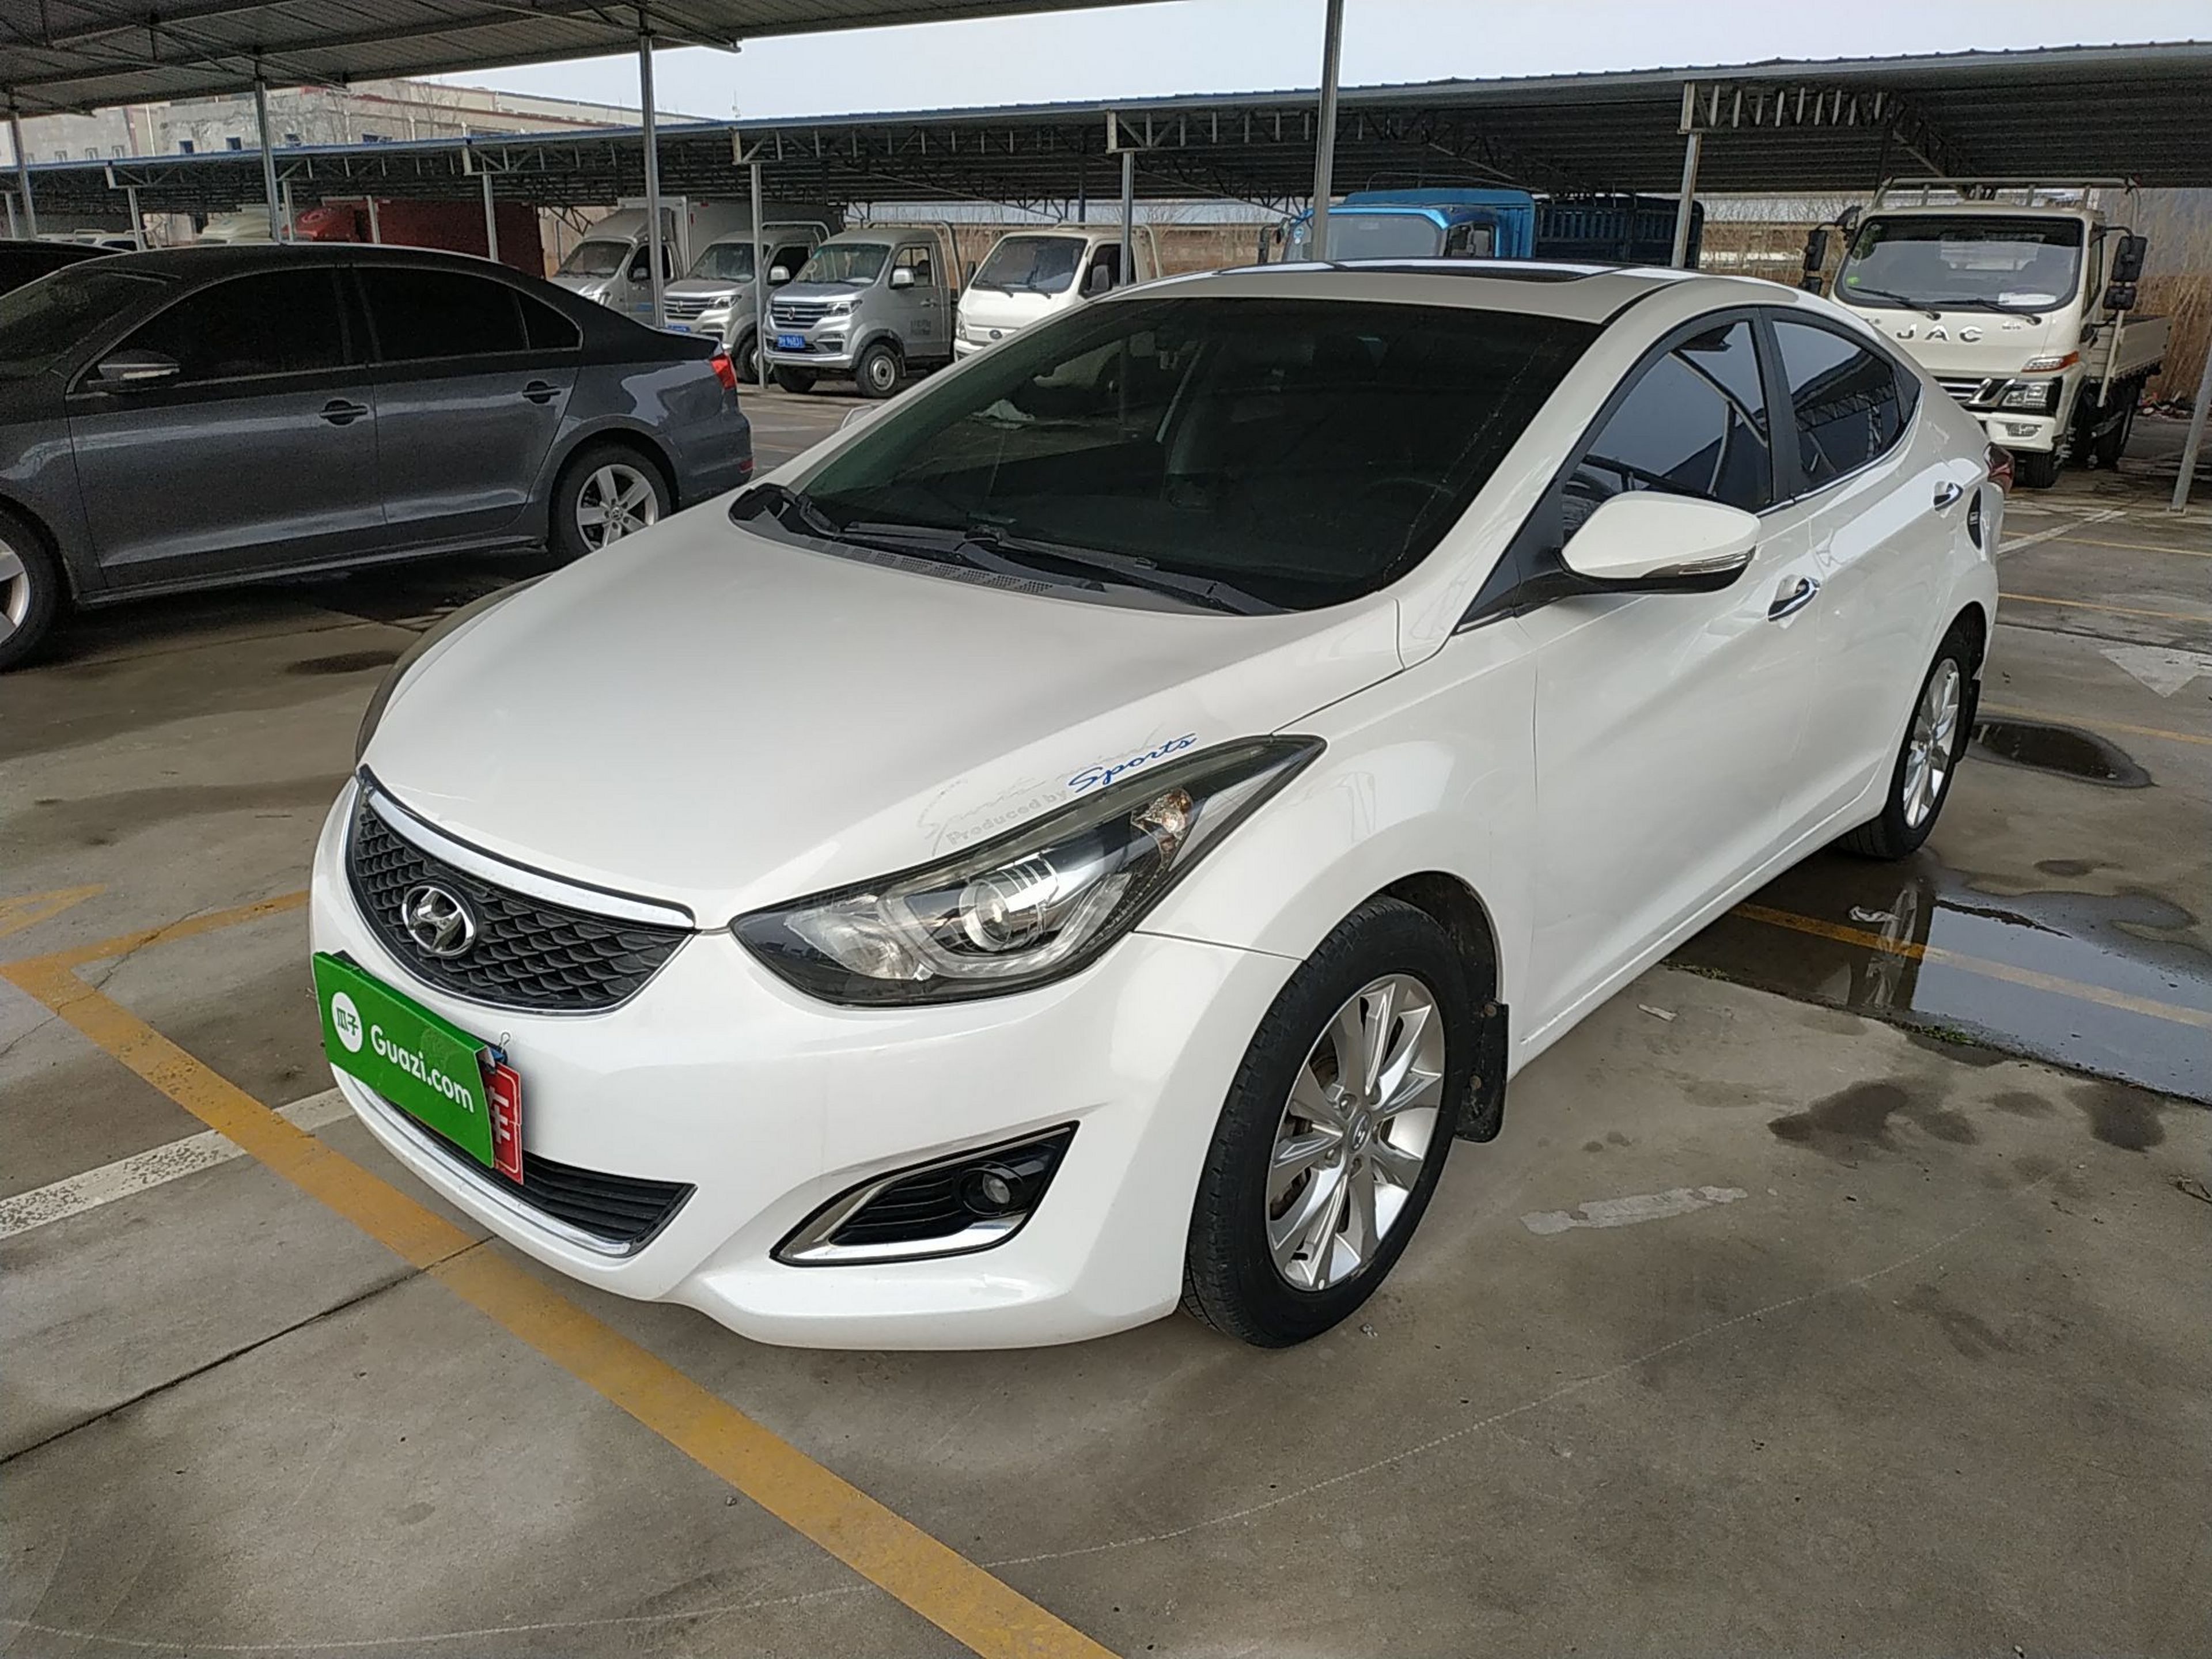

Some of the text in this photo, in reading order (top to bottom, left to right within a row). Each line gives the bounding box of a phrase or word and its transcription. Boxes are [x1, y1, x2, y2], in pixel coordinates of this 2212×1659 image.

[1896, 324, 1983, 342] JAC
[946, 733, 1197, 845] Produced by Sports
[336, 1006, 359, 1036] 瓜子
[370, 1024, 474, 1113] Guazi.com
